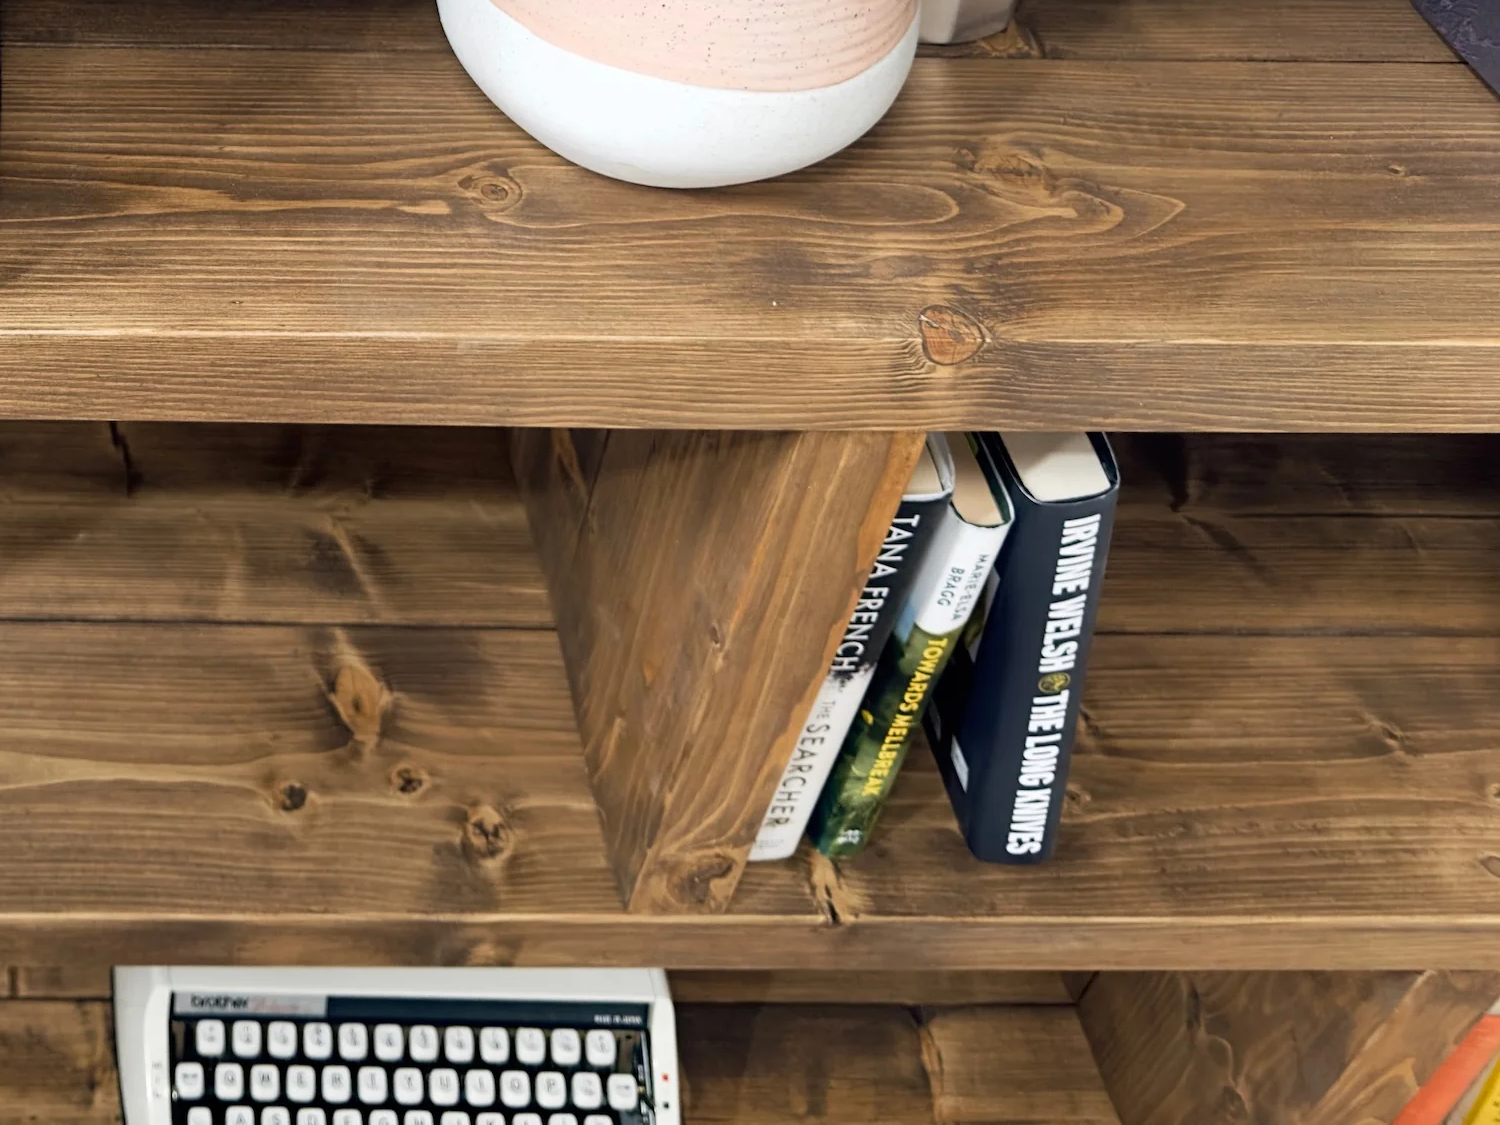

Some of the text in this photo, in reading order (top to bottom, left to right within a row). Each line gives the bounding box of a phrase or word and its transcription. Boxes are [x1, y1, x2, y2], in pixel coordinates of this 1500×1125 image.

[829, 513, 920, 674] TANA FRENCH
[936, 567, 963, 607] BRAGG
[951, 554, 989, 621] MARIE-ELSA
[1039, 513, 1101, 674] IRVINE WELSH
[818, 700, 836, 722] THE
[861, 637, 949, 797] TOWARDS MELLBREAK
[764, 722, 828, 827] SEARCHER
[1006, 690, 1069, 855] THE LONG KNIVES
[190, 995, 248, 1008] brother
